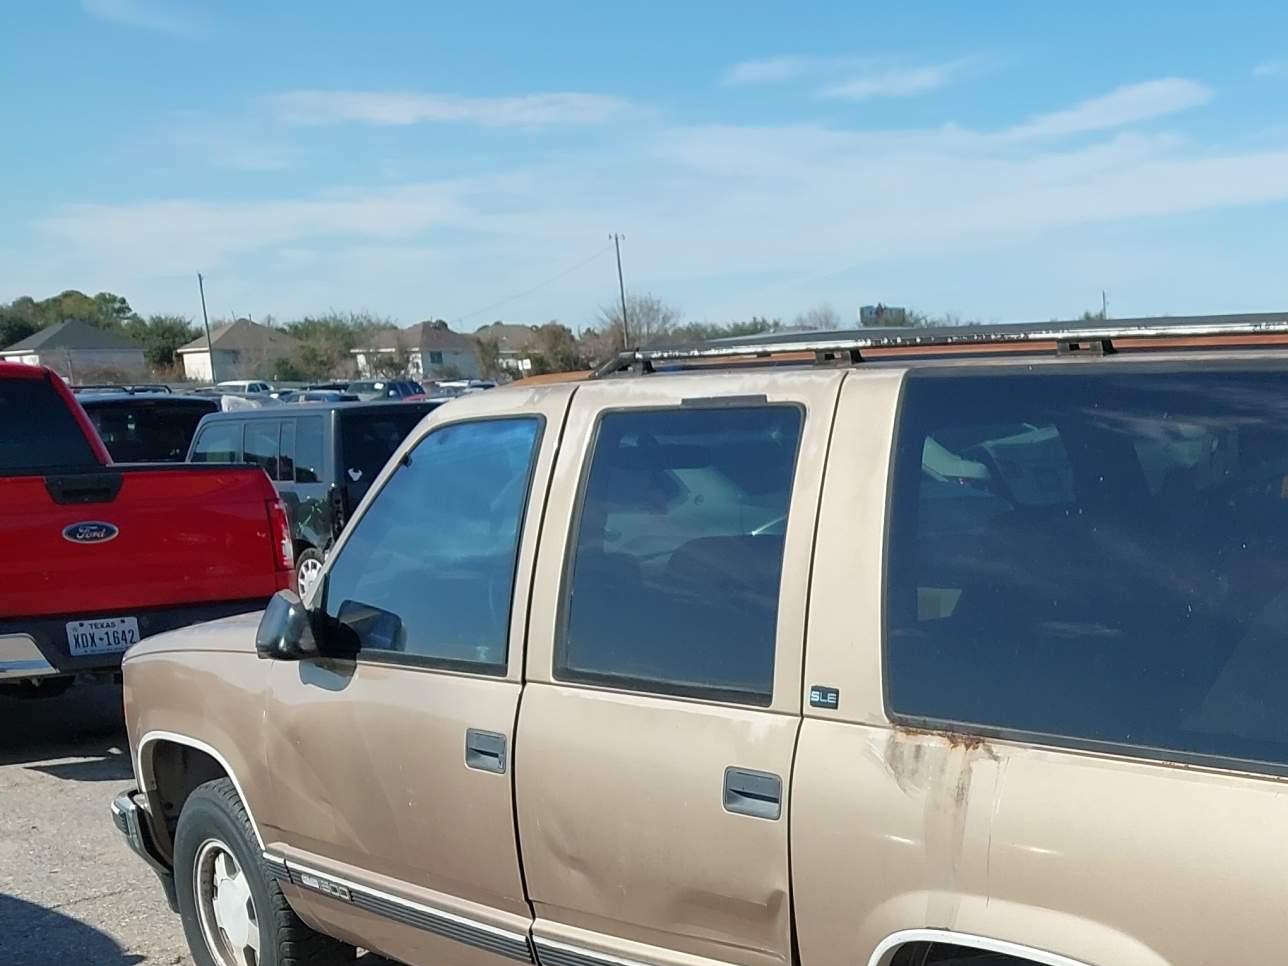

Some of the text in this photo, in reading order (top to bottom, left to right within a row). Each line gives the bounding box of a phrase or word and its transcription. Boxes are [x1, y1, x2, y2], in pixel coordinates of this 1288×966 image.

[89, 621, 117, 630] TEXAS
[73, 629, 137, 649] XDX-1642
[810, 690, 837, 704] SLE
